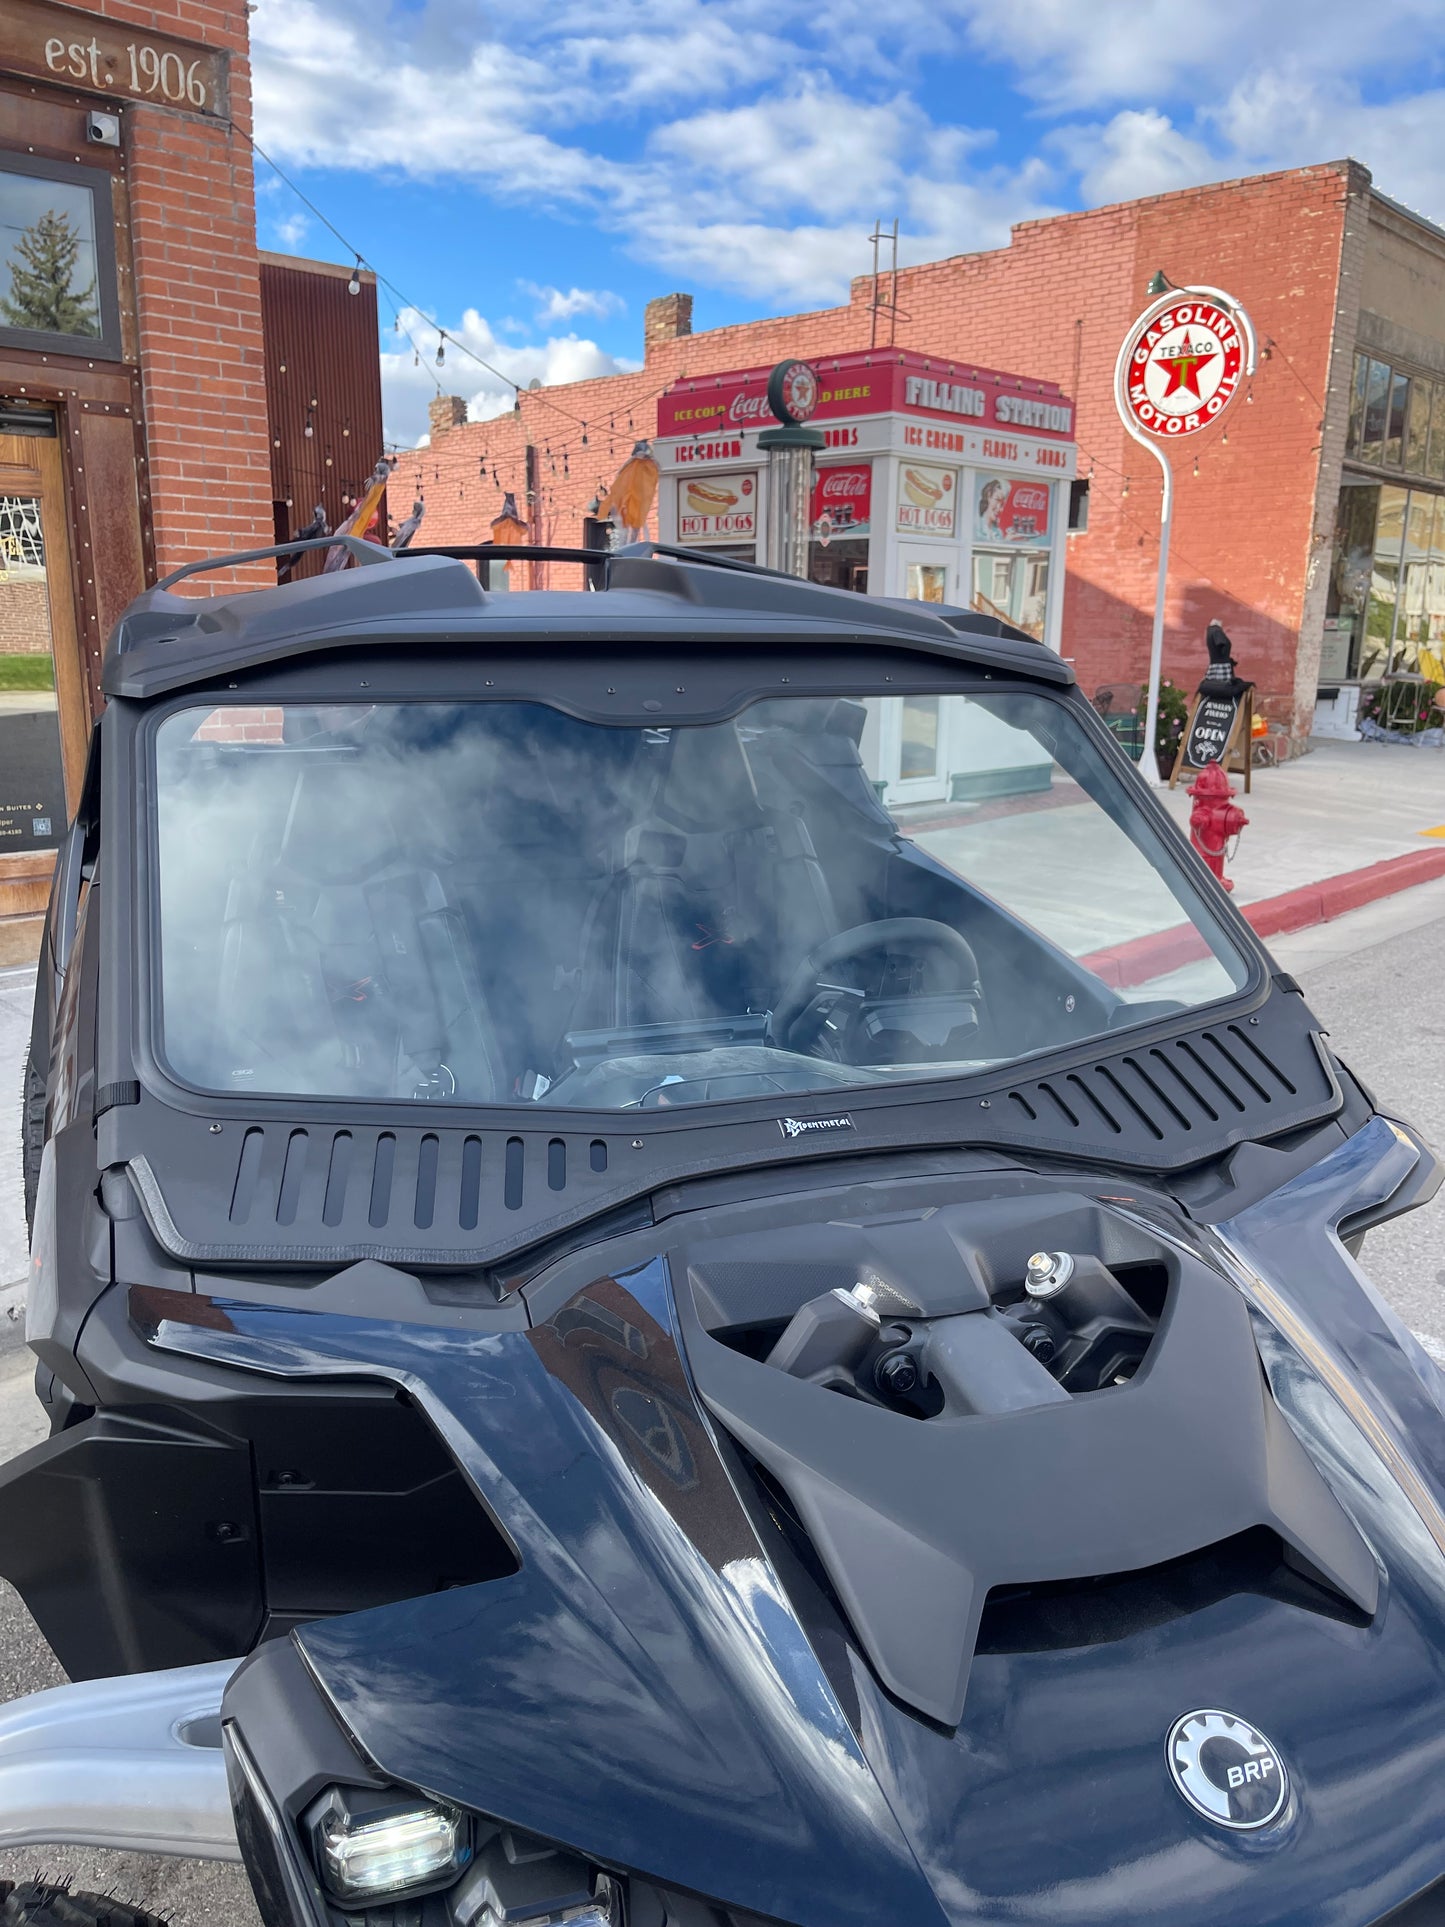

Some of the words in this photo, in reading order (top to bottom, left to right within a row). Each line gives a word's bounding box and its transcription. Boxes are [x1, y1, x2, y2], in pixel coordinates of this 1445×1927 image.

[45, 37, 114, 89] est.
[127, 43, 206, 106] 1906
[1134, 307, 1239, 365] GASOLINE
[1160, 342, 1214, 357] TEXACO
[834, 385, 871, 401] HERE
[905, 376, 986, 417] FILLING
[995, 395, 1073, 433] STATION
[1130, 384, 1200, 433] MOTOR
[1206, 372, 1238, 414] OIL
[674, 409, 693, 421] ICE
[695, 405, 726, 419] COLD
[675, 446, 694, 463] ICE
[698, 440, 742, 461] CREAM
[904, 426, 923, 446] ICE
[926, 429, 965, 453] CREAM
[983, 439, 1018, 461] FLOATS
[1036, 448, 1067, 468] SODAS
[682, 517, 709, 533] HOT
[715, 515, 753, 531] DOGS
[898, 507, 921, 525] HOT
[924, 509, 952, 528] DOGS
[1195, 727, 1226, 742] OPEN
[1226, 1757, 1274, 1789] BRP
